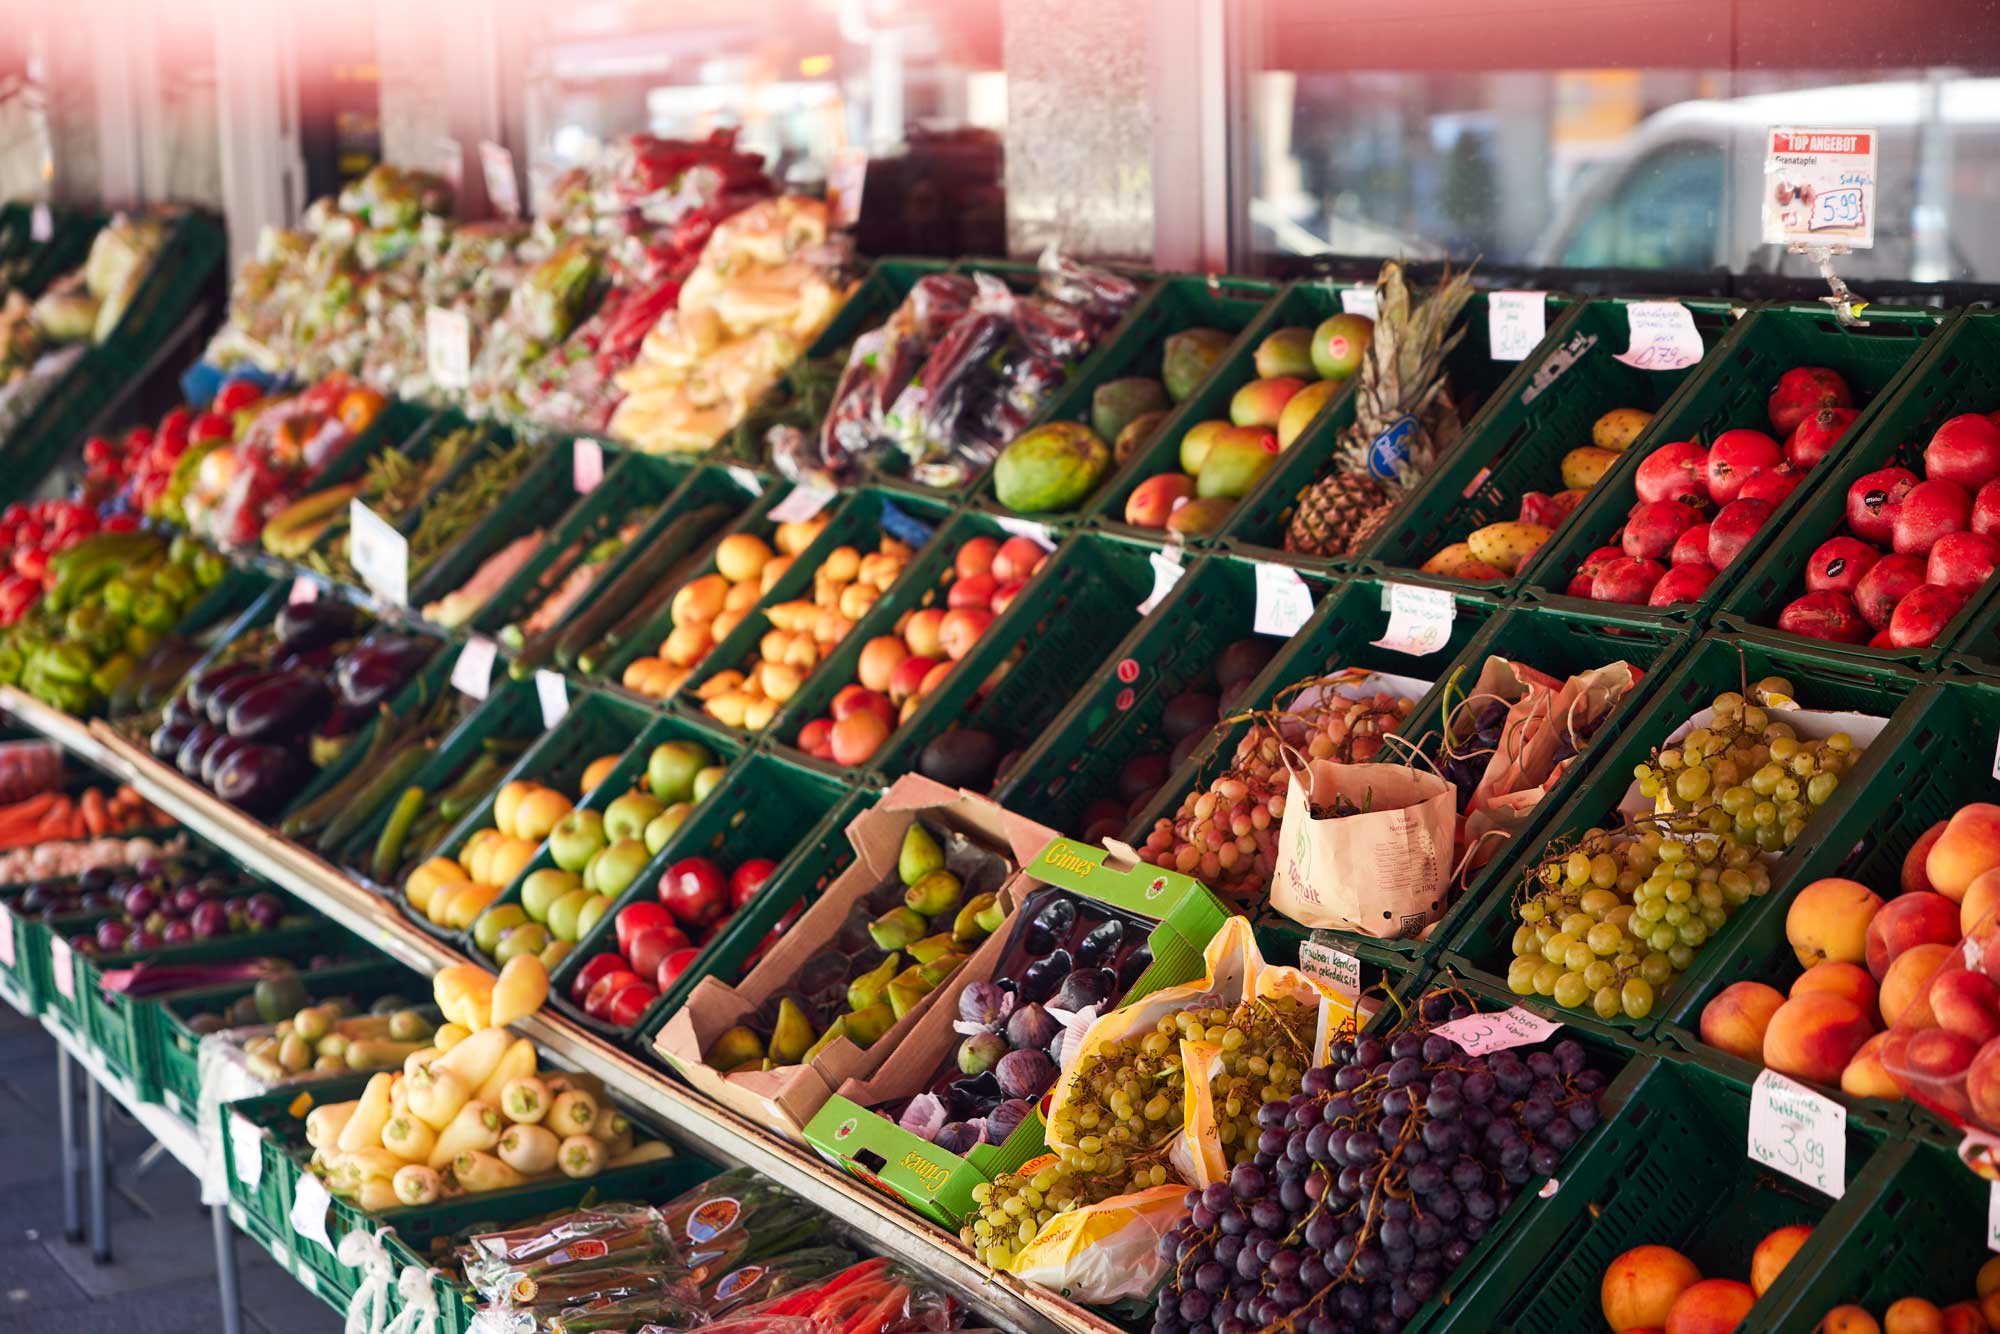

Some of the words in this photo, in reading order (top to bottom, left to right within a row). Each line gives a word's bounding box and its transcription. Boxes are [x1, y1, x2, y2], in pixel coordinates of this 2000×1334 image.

[1788, 135, 1808, 150] TOP
[1810, 137, 1857, 152] ANGEBOT
[1775, 156, 1817, 167] Granatapfel
[1045, 842, 1096, 878] Güneş
[1301, 943, 1330, 965] Trauben
[1769, 1097, 1815, 1128] Nektarin
[1777, 1124, 1825, 1174] 3,99
